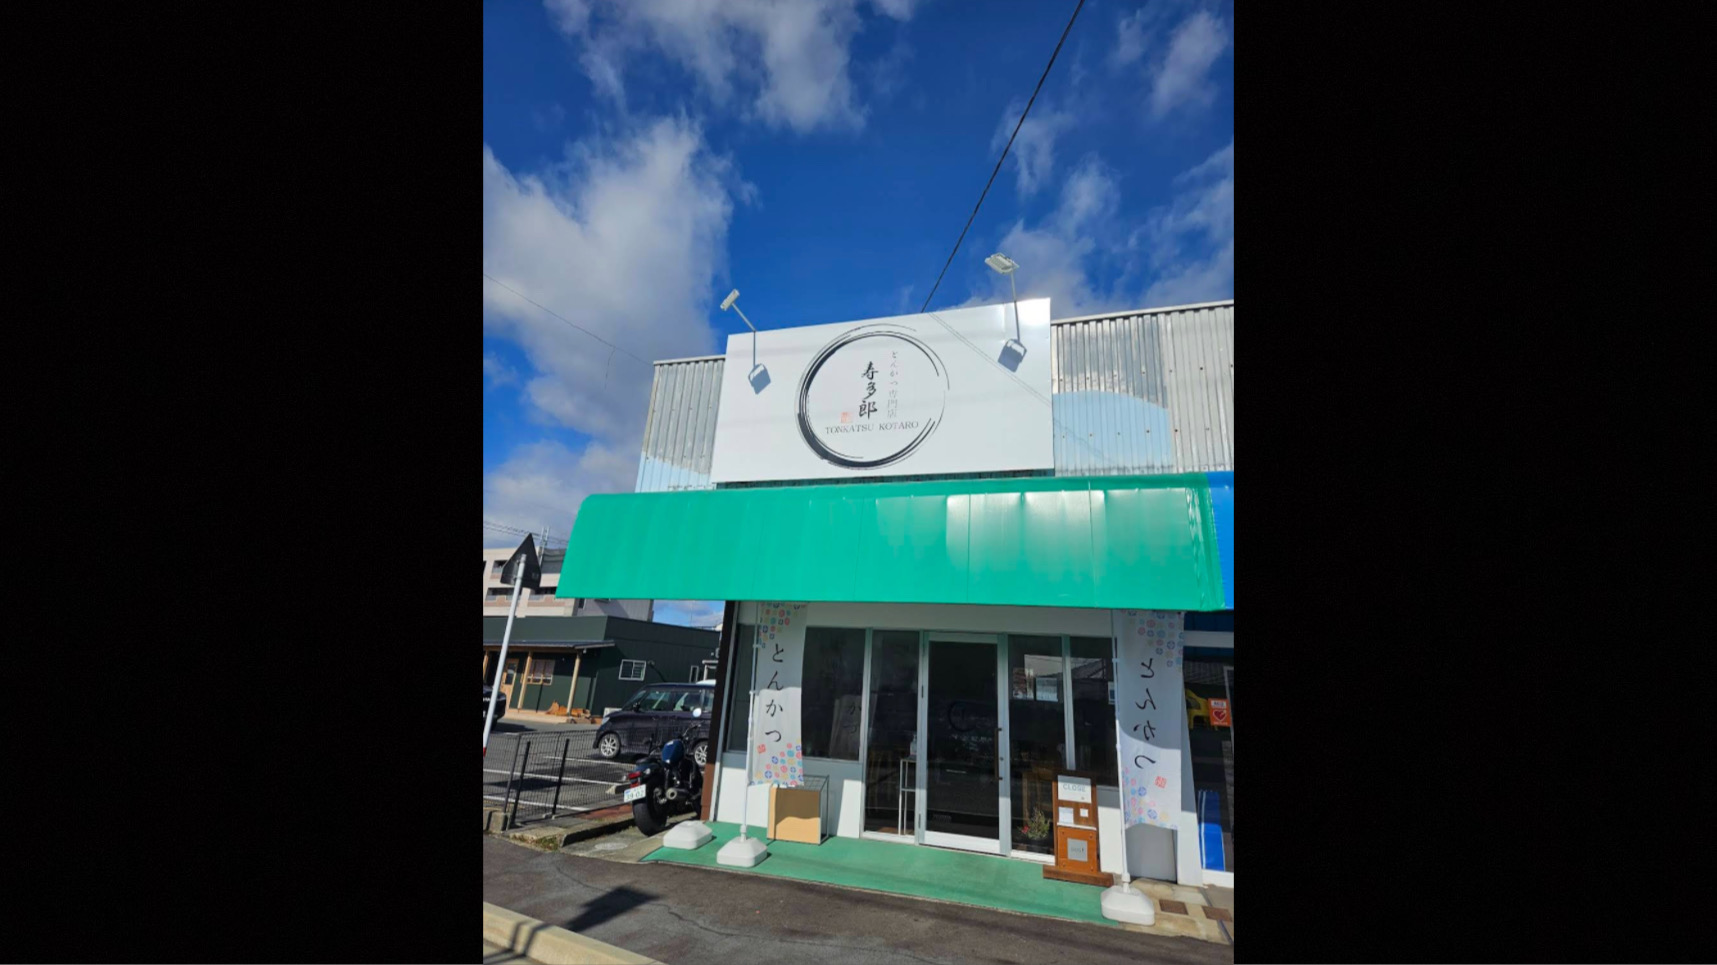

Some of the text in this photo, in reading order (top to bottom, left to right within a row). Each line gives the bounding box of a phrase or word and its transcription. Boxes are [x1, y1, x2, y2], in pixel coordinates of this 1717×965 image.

[825, 421, 919, 435] TONKATSU KOTARO
[765, 643, 784, 743] とんかつ
